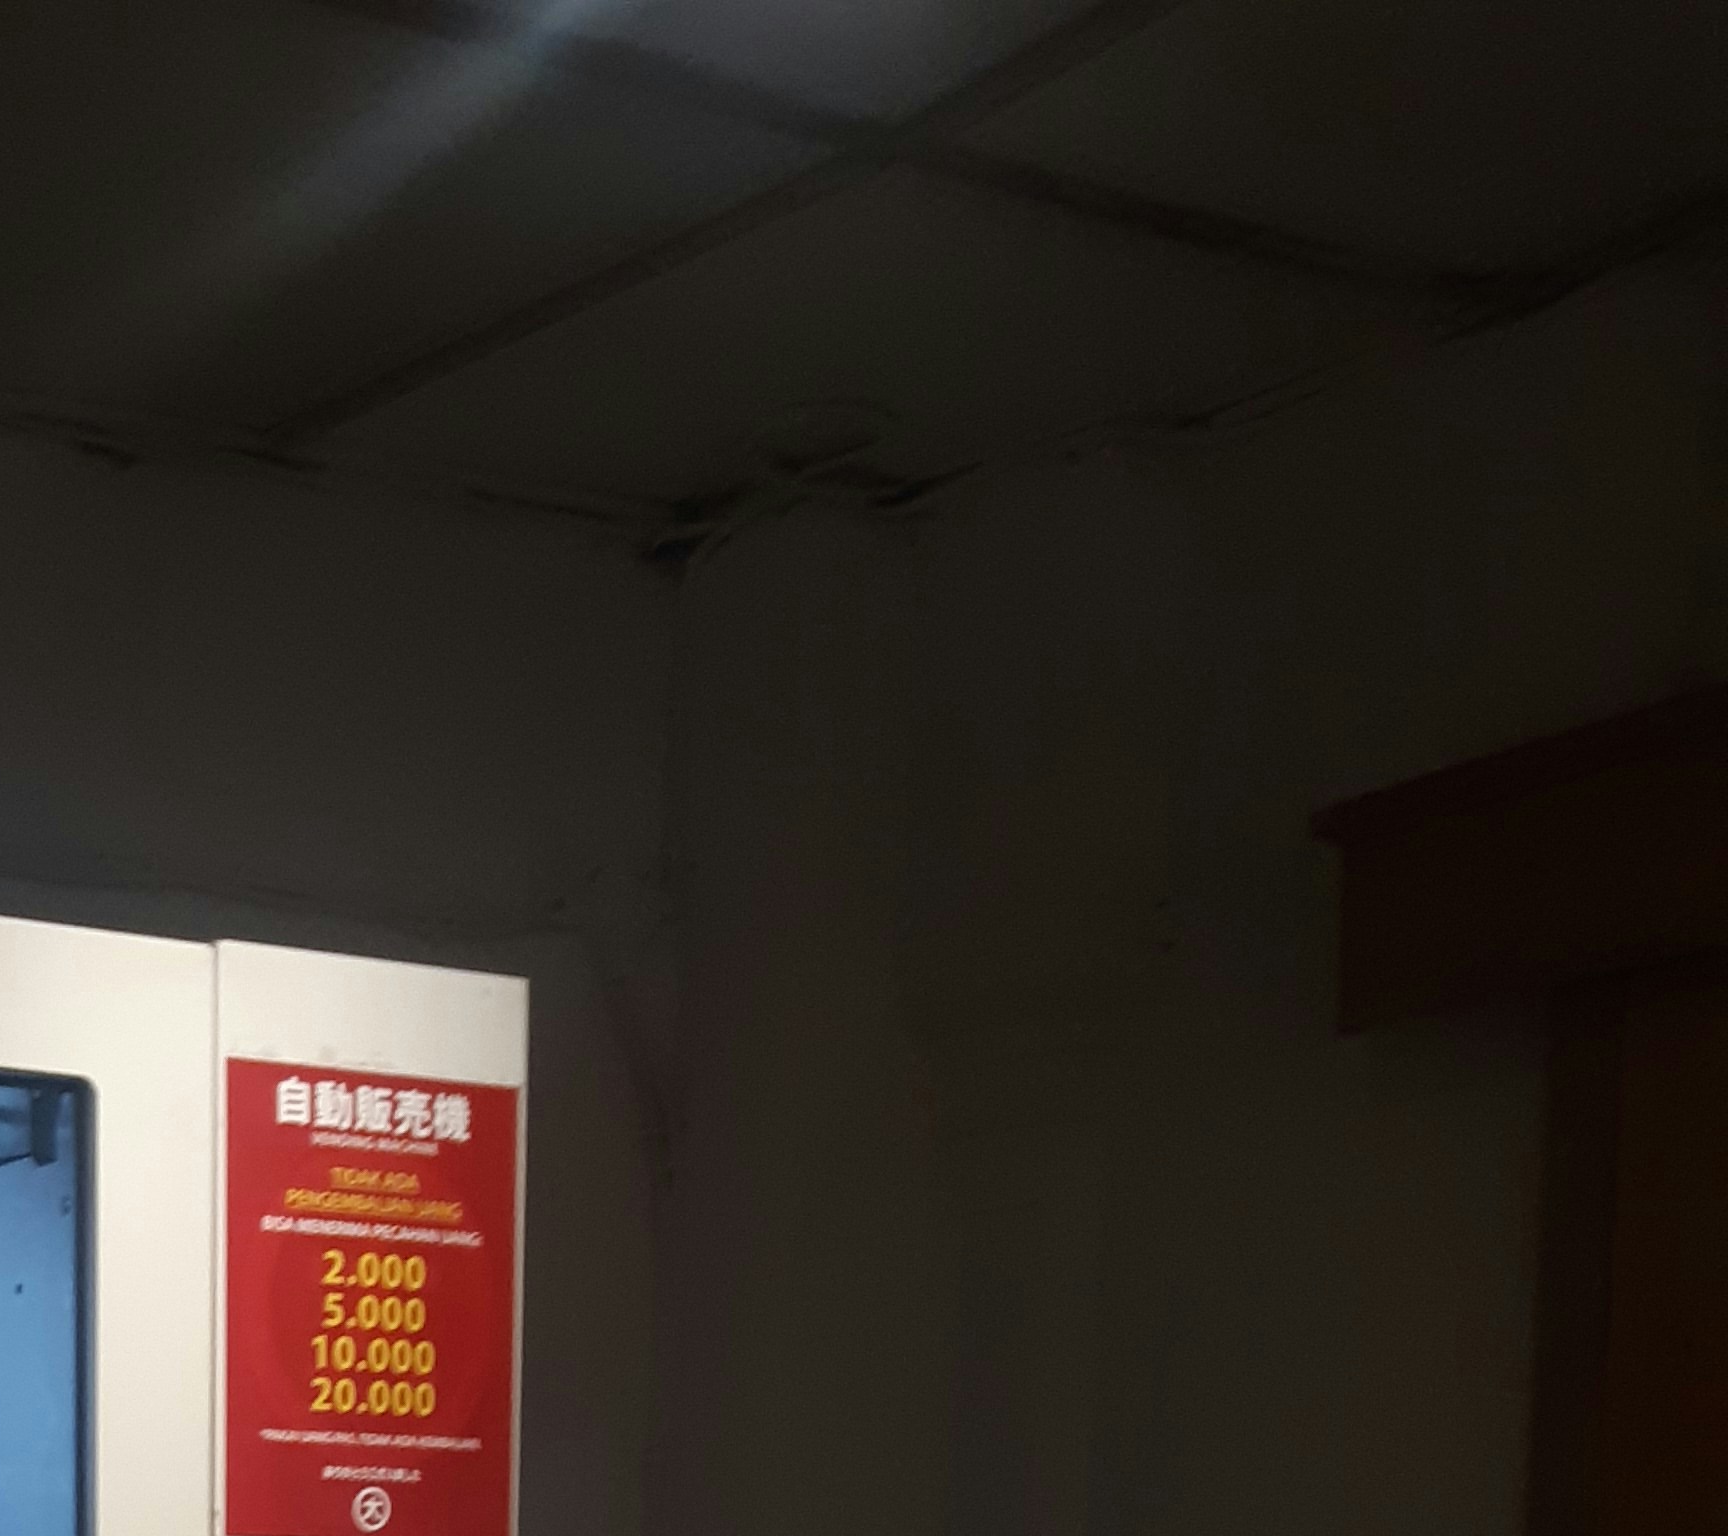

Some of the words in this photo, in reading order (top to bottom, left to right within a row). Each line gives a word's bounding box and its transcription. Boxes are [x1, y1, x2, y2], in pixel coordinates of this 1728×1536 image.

[276, 1076, 471, 1143] 自動販売機
[321, 1249, 426, 1291] 2.000
[321, 1292, 426, 1332] 5.000
[311, 1334, 436, 1375] 10.000
[309, 1376, 436, 1417] 20.000
